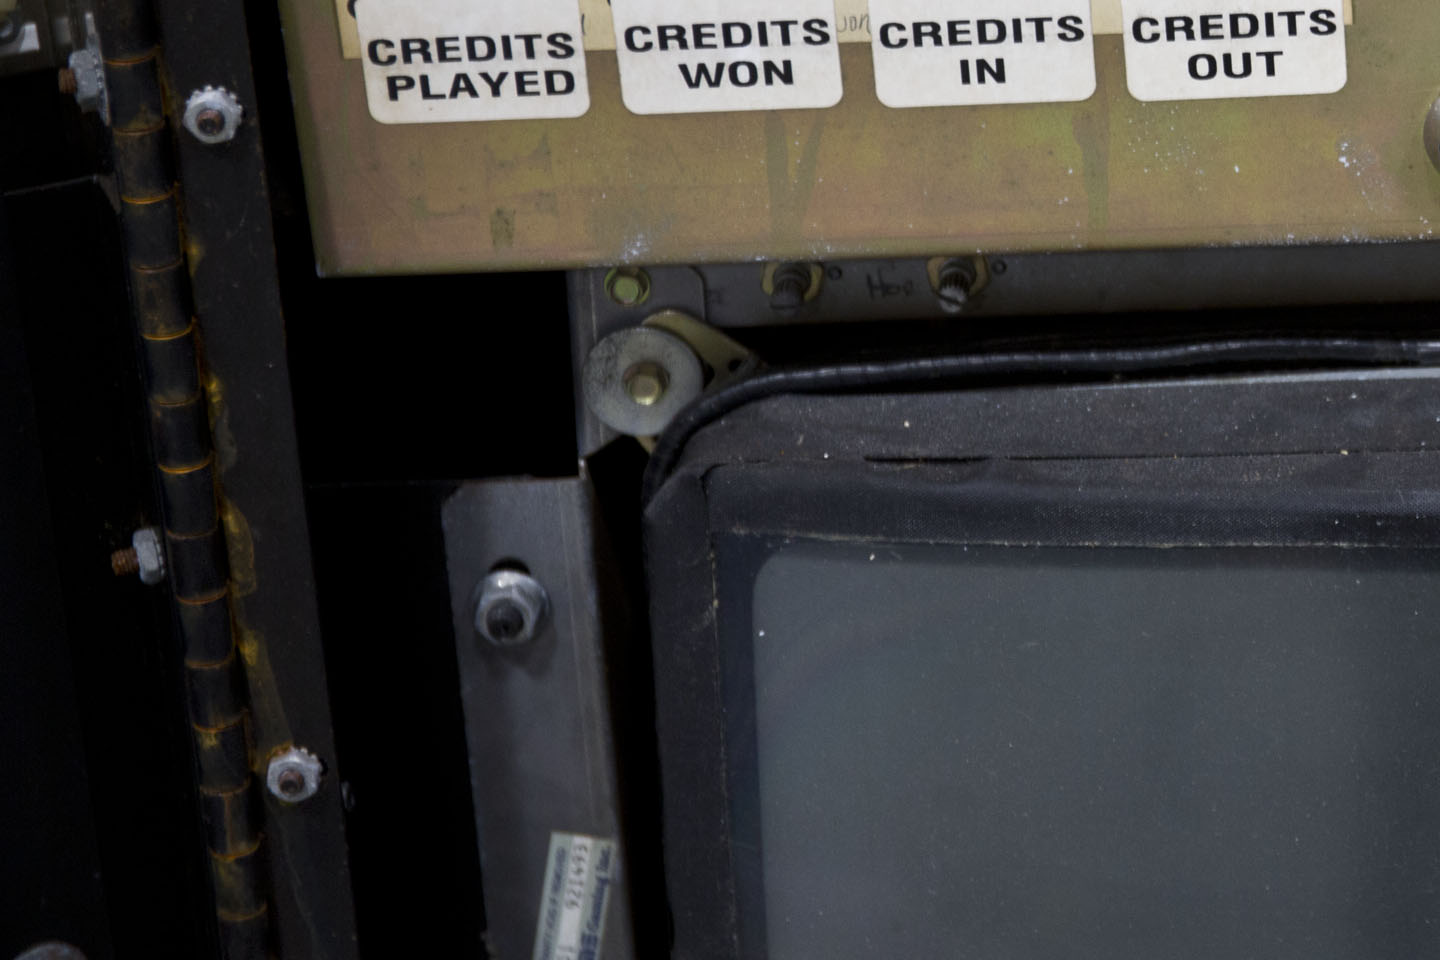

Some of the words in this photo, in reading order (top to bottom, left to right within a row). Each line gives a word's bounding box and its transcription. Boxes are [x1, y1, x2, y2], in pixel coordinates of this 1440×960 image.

[623, 18, 831, 53] CREDITS
[879, 15, 1085, 49] CREDITS
[1131, 9, 1337, 43] CREDITS
[367, 32, 576, 67] CREDITS
[1187, 50, 1285, 80] OUT
[386, 70, 576, 101] PLAYED
[679, 59, 795, 89] WON
[959, 57, 1007, 85] IN
